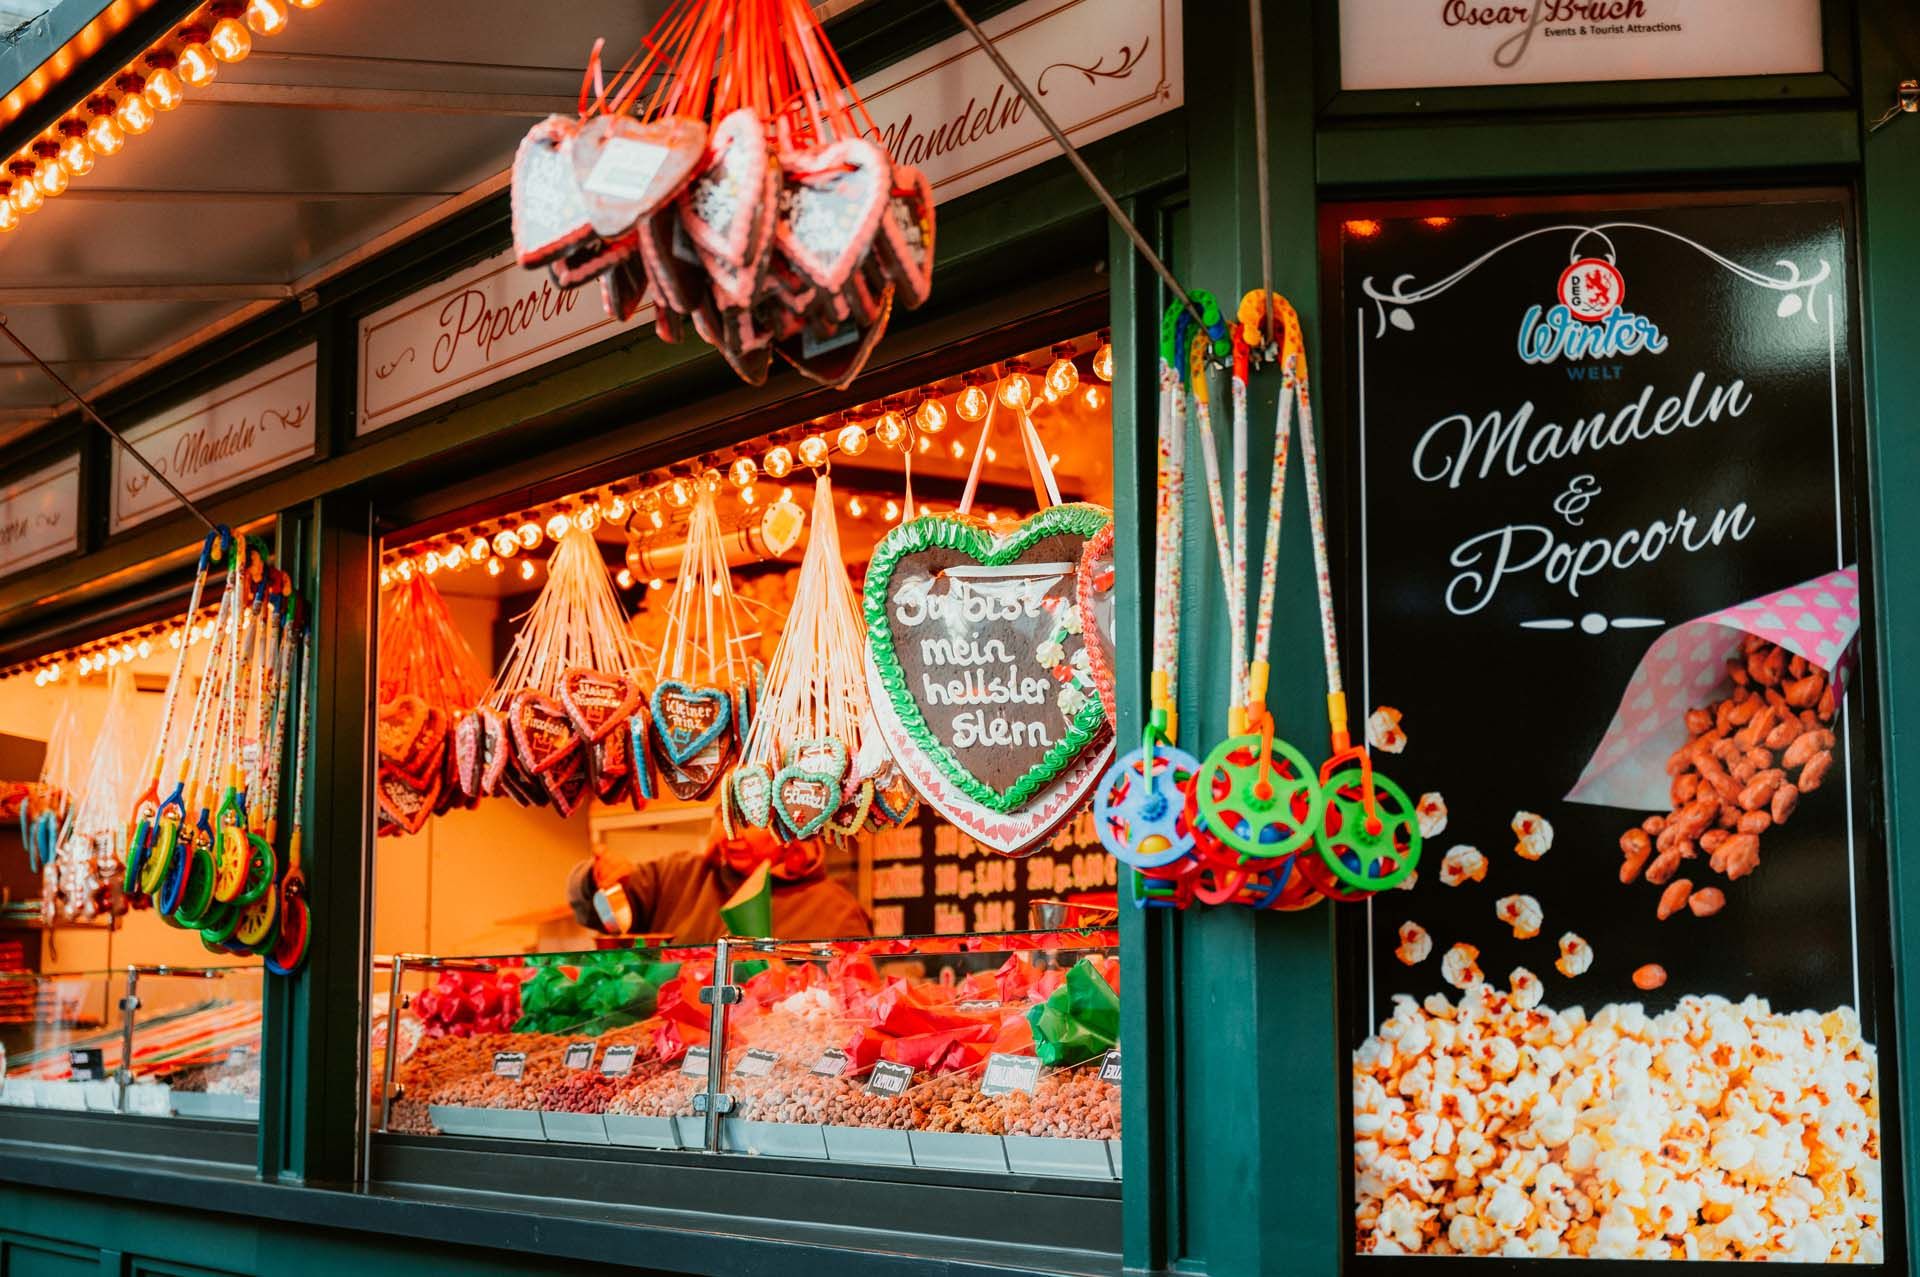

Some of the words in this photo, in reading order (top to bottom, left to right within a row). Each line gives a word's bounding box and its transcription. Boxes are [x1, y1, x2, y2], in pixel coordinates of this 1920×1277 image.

[1442, 0, 1530, 26] Oscar
[1544, 26, 1576, 37] Events
[1579, 25, 1587, 35] &
[1590, 24, 1624, 35] Tourist
[1627, 22, 1682, 33] Attractions
[862, 84, 1027, 165] Mandeln
[433, 279, 580, 374] Popcorn
[1518, 304, 1668, 364] Winter
[1567, 366, 1623, 380] WELT
[173, 417, 256, 478] Mandeln
[1412, 371, 1753, 488] Mandeln
[1553, 474, 1602, 526] &
[1445, 501, 1756, 615] Popcorn
[921, 632, 1016, 667] mein
[922, 664, 1051, 705] hellster
[665, 699, 713, 719] Kleiner
[951, 709, 1054, 749] Stern
